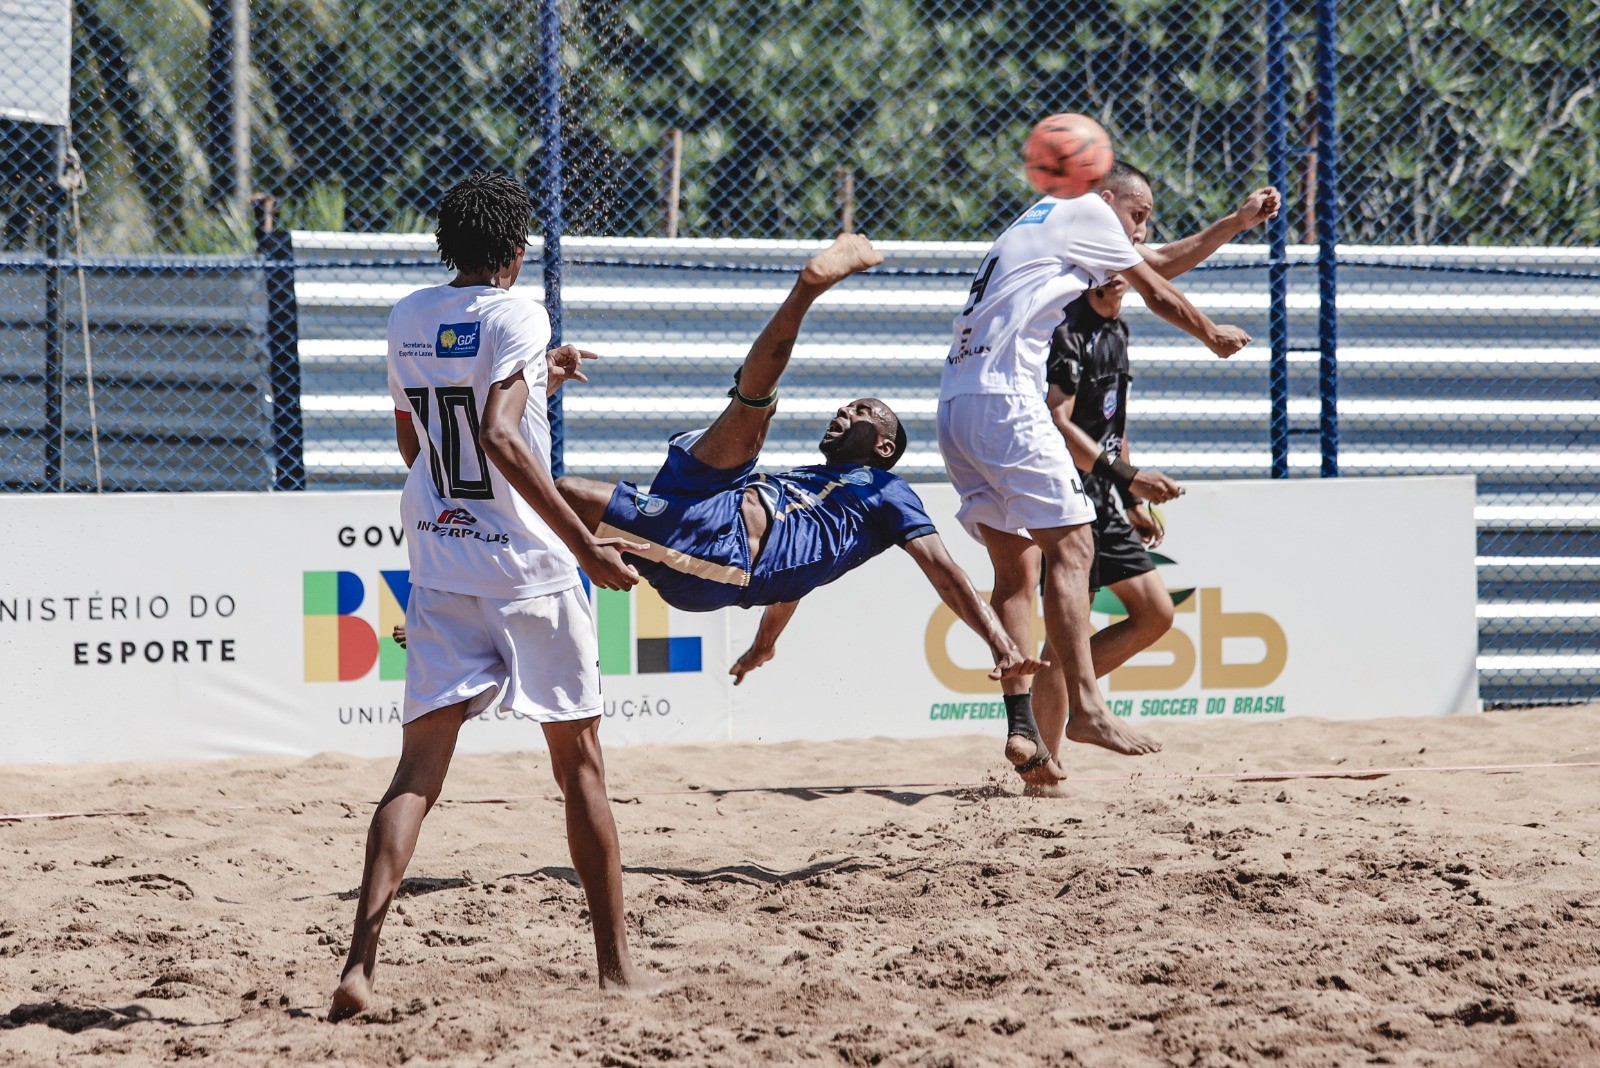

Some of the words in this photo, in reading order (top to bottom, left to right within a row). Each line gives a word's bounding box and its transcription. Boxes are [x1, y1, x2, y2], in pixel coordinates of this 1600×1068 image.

[457, 333, 477, 346] GDF
[404, 387, 495, 500] 10
[416, 520, 510, 544] INTERPLUS
[0, 591, 170, 622] NISTÉRIO
[190, 595, 236, 618] DO
[73, 639, 236, 665] ESPORTE
[338, 702, 401, 725] UNIÃ
[929, 702, 1008, 721] CONFEDER
[1140, 698, 1199, 717] SOCCER
[1205, 697, 1227, 715] DO
[1233, 695, 1286, 714] BRASIL
